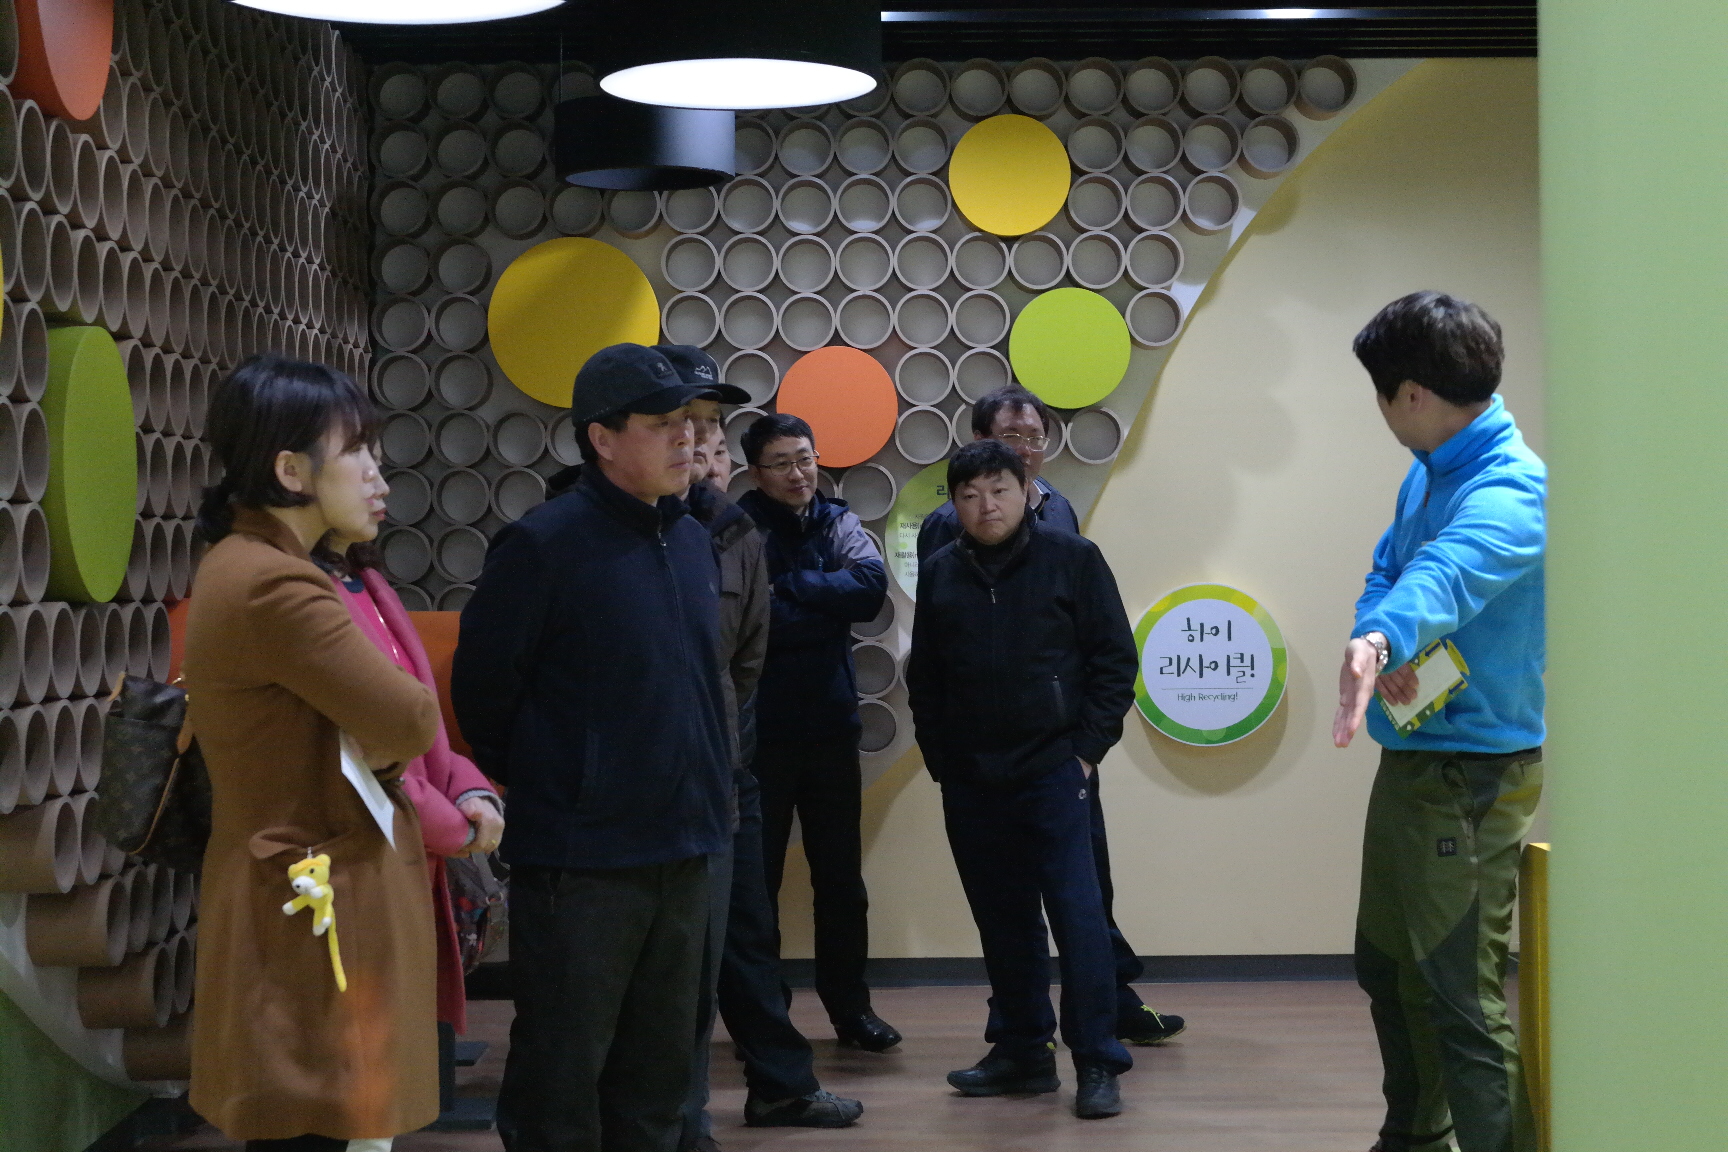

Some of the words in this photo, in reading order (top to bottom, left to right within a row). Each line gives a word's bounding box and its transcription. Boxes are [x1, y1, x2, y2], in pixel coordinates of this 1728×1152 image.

[1181, 617, 1232, 642] 하이
[1159, 652, 1255, 684] 리사이클!
[1177, 693, 1196, 702] High
[1198, 692, 1238, 702] Recycling!
